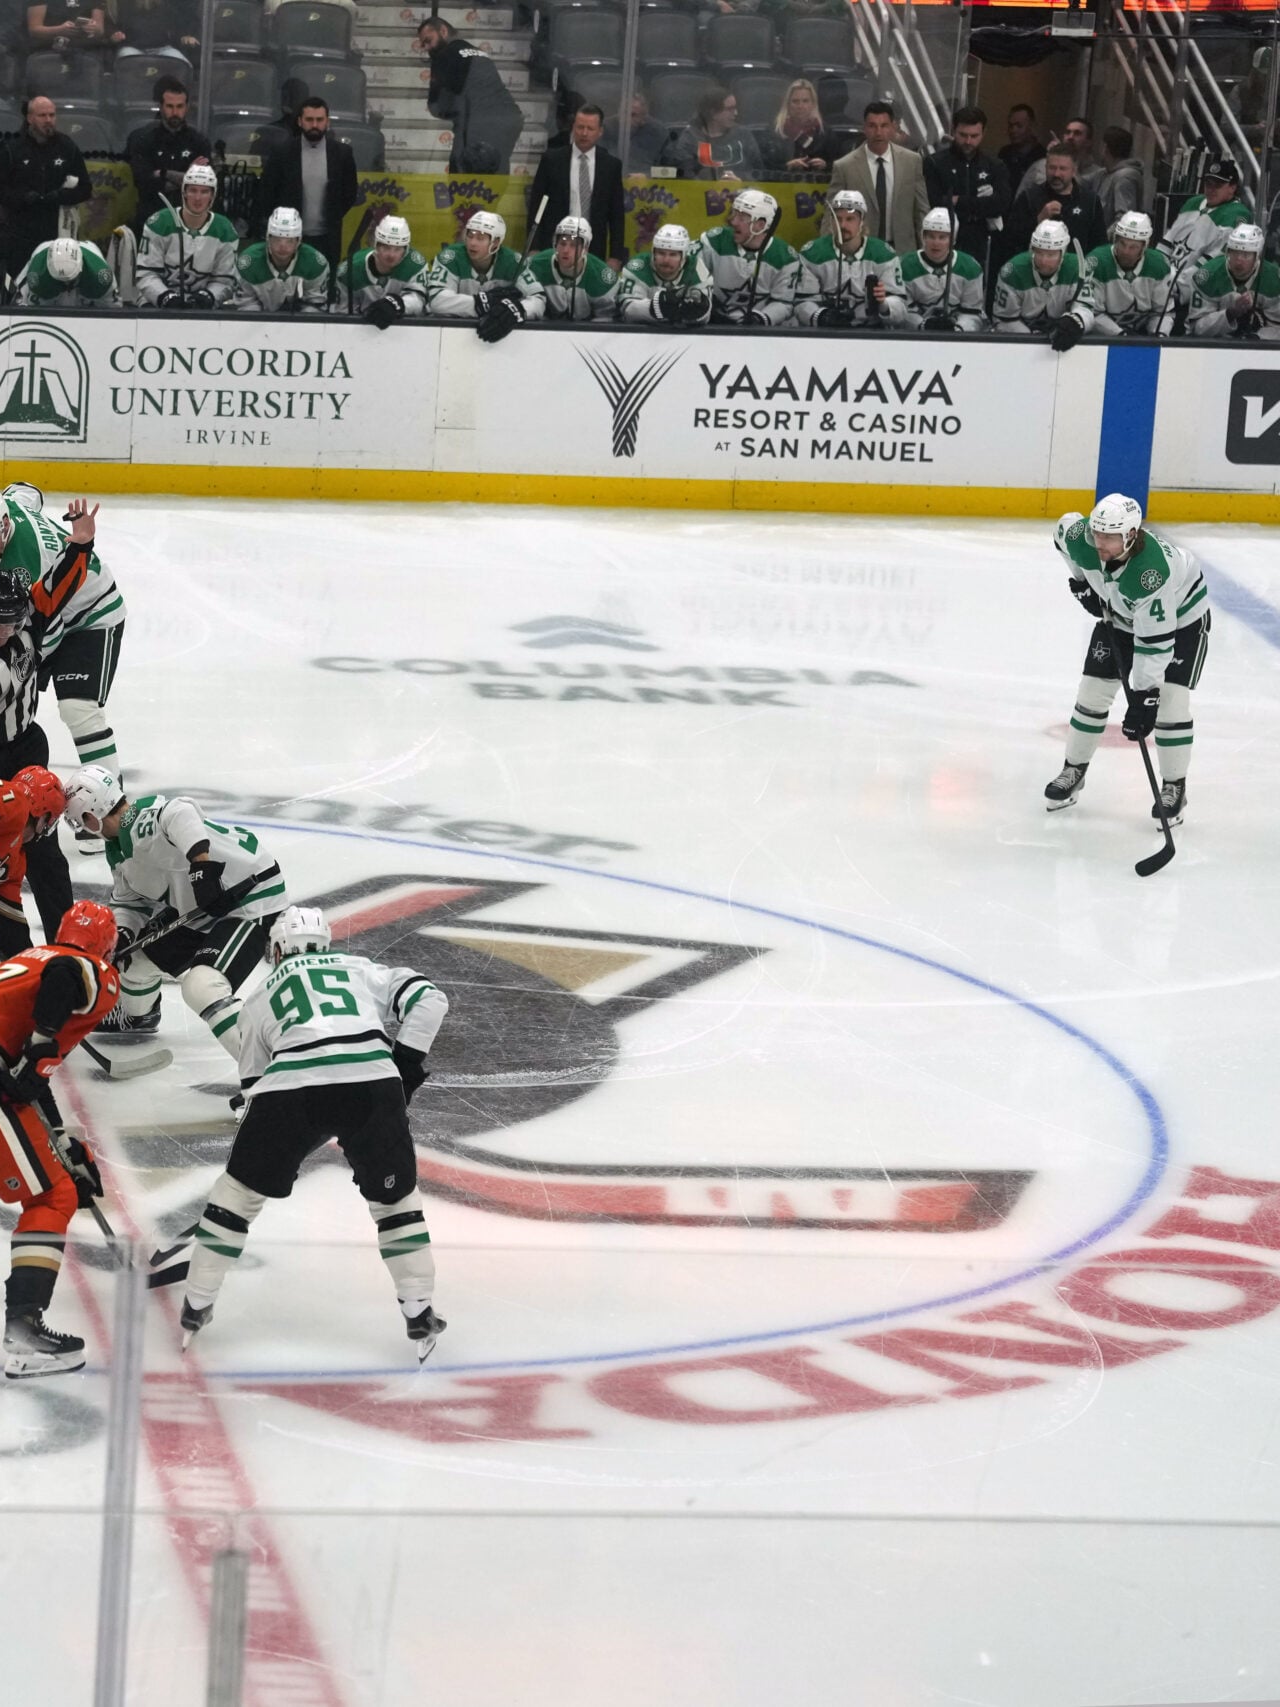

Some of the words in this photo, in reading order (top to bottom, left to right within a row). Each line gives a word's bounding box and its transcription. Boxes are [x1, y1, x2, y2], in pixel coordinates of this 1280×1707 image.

[429, 265, 448, 284] 21
[500, 297, 524, 323] CCM
[109, 344, 353, 379] CONCORDIA
[109, 386, 352, 421] UNIVERSITY
[693, 407, 811, 432] RESORT
[819, 411, 837, 432] &
[847, 412, 962, 436] CASINO
[185, 429, 271, 446] IRVINE
[714, 441, 731, 452] AT
[740, 440, 800, 459] SAN
[810, 440, 934, 463] MANUEL
[1149, 598, 1166, 622] 4
[57, 673, 89, 681] CCM
[310, 655, 925, 688] COLUMBIA
[467, 680, 805, 707] BANK
[266, 957, 343, 991] DUCHENE
[269, 968, 361, 1037] 95
